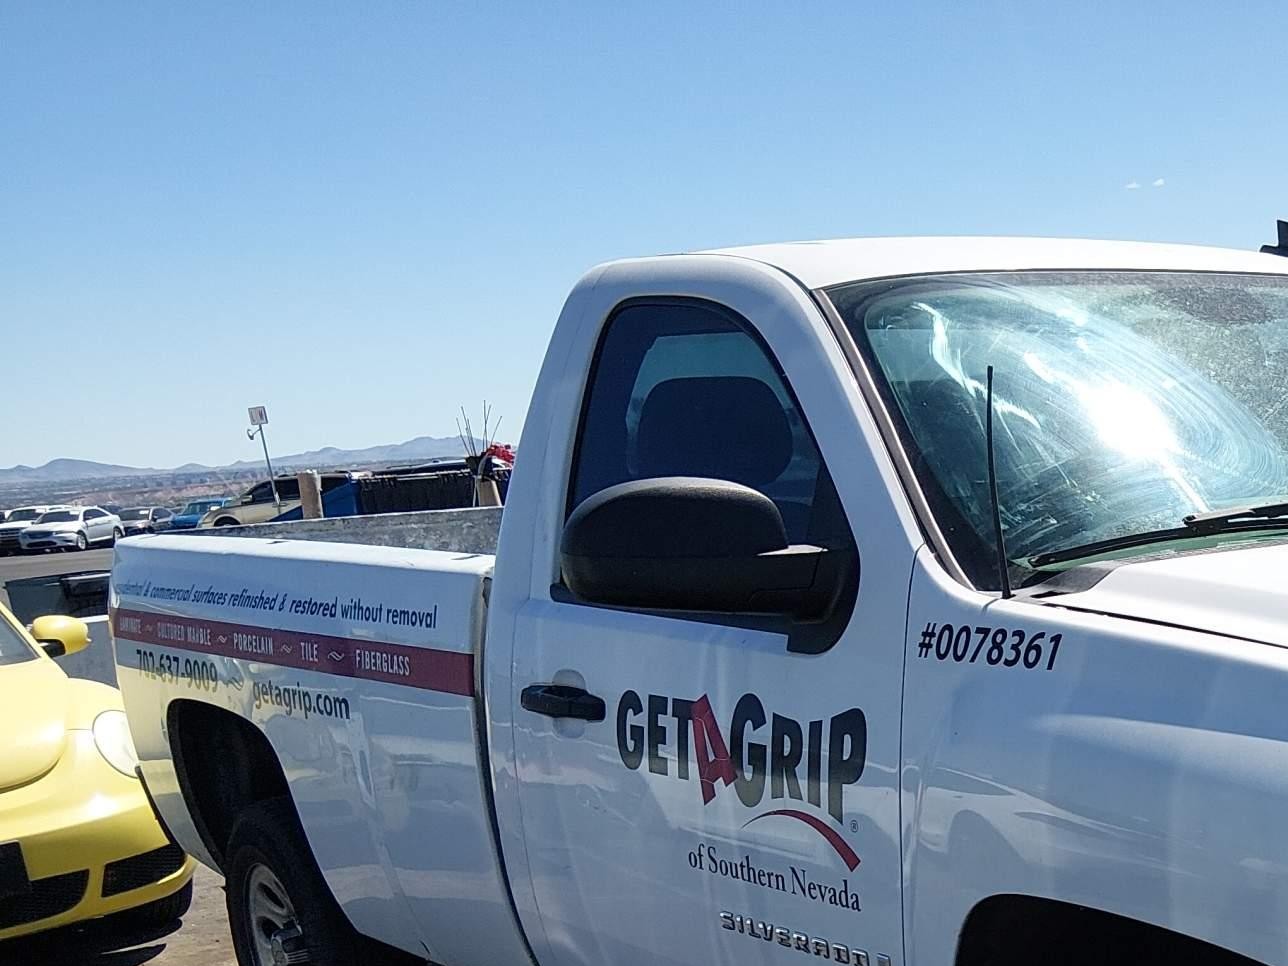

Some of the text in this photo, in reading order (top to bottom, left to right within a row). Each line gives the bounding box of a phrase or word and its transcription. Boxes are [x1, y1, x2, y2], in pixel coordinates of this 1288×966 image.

[150, 583, 195, 602] commercial
[192, 585, 227, 606] surfaces
[227, 588, 279, 611] refinished
[278, 593, 288, 612] &
[288, 596, 338, 619] restored
[341, 598, 383, 624] without
[386, 604, 438, 629] removal
[157, 622, 186, 642] CULTURED
[187, 626, 212, 646] MARBLE
[233, 632, 274, 656] PORCELAIN
[300, 641, 319, 662] TILE
[355, 649, 411, 676] FIBERGLASS
[918, 621, 1063, 671] #0078361
[136, 649, 218, 692] 702-637-9009
[253, 680, 351, 721] getagrip.com
[688, 844, 861, 913] of Southern Nevada
